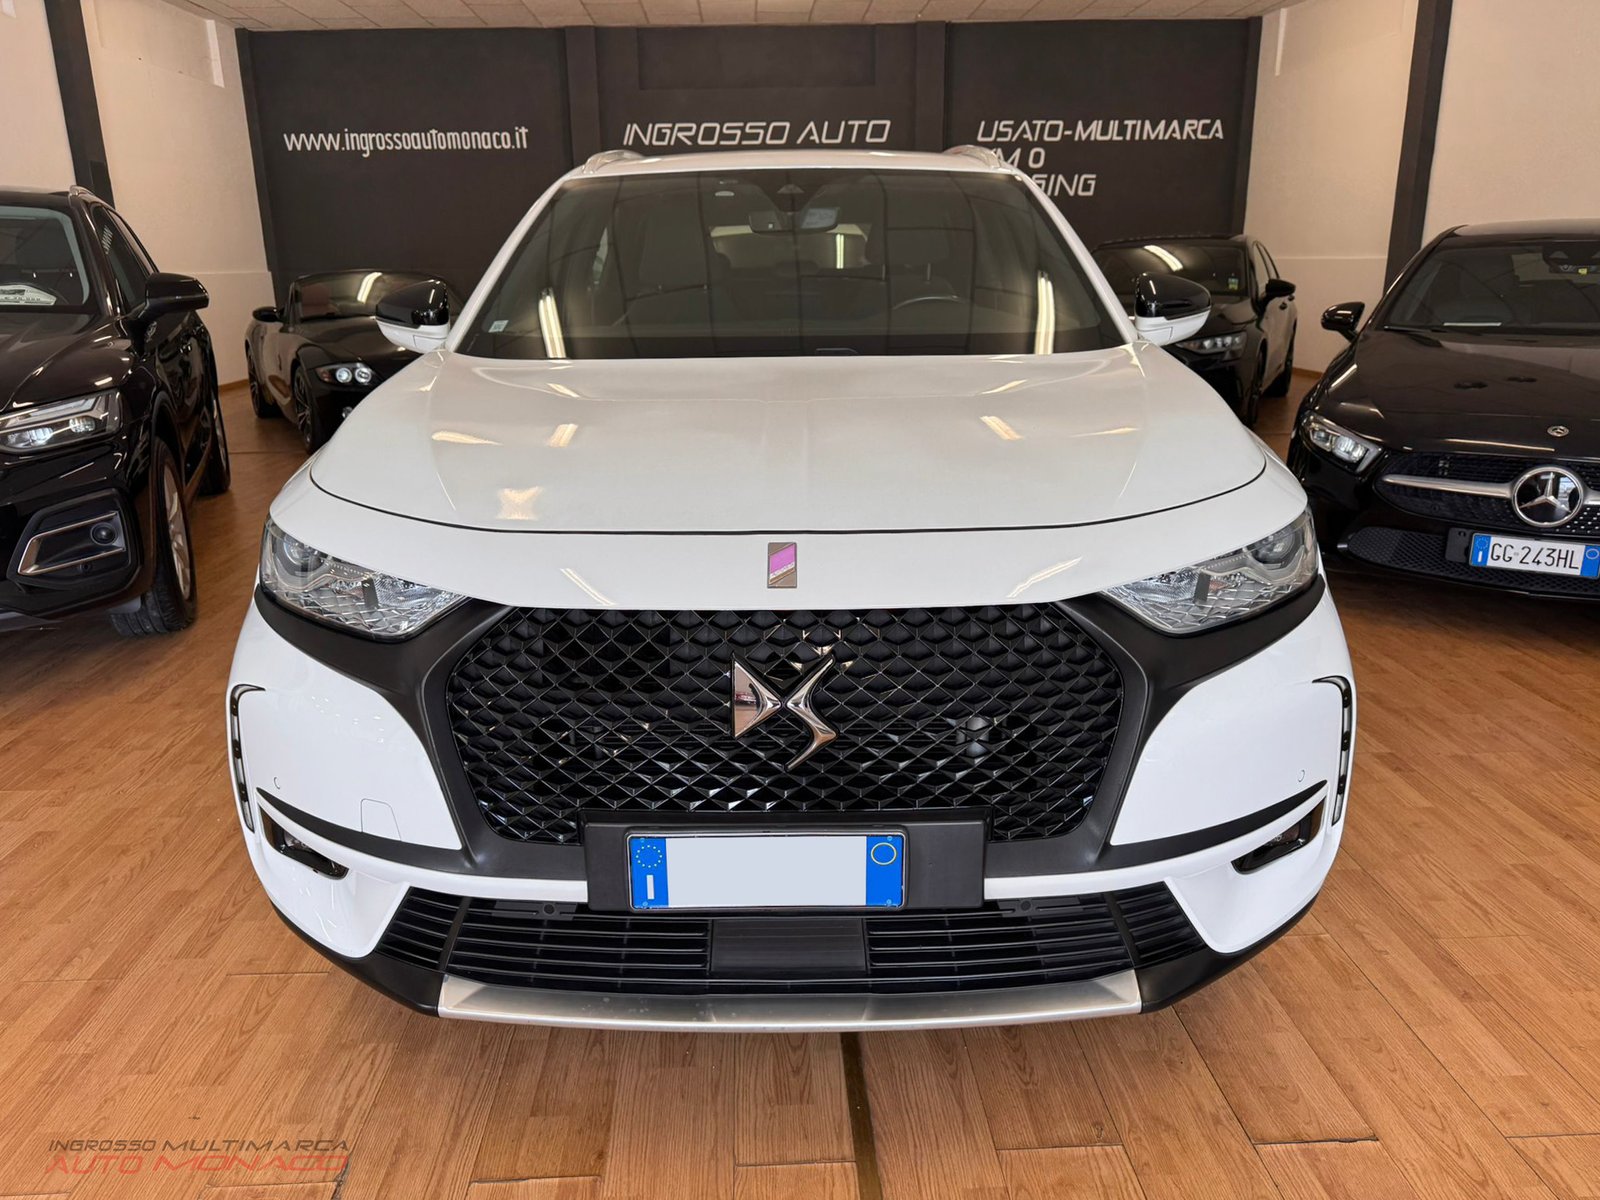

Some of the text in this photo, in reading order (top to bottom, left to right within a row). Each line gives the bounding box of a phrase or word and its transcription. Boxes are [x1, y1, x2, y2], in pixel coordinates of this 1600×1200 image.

[283, 126, 529, 158] www.ingrossoautomonaco.it
[623, 119, 892, 147] INGROSSO AUTO
[977, 119, 1225, 142] USATO-MULTIMARCA
[991, 147, 1022, 168] M
[1491, 543, 1514, 562] GG
[1519, 546, 1579, 569] 243HL
